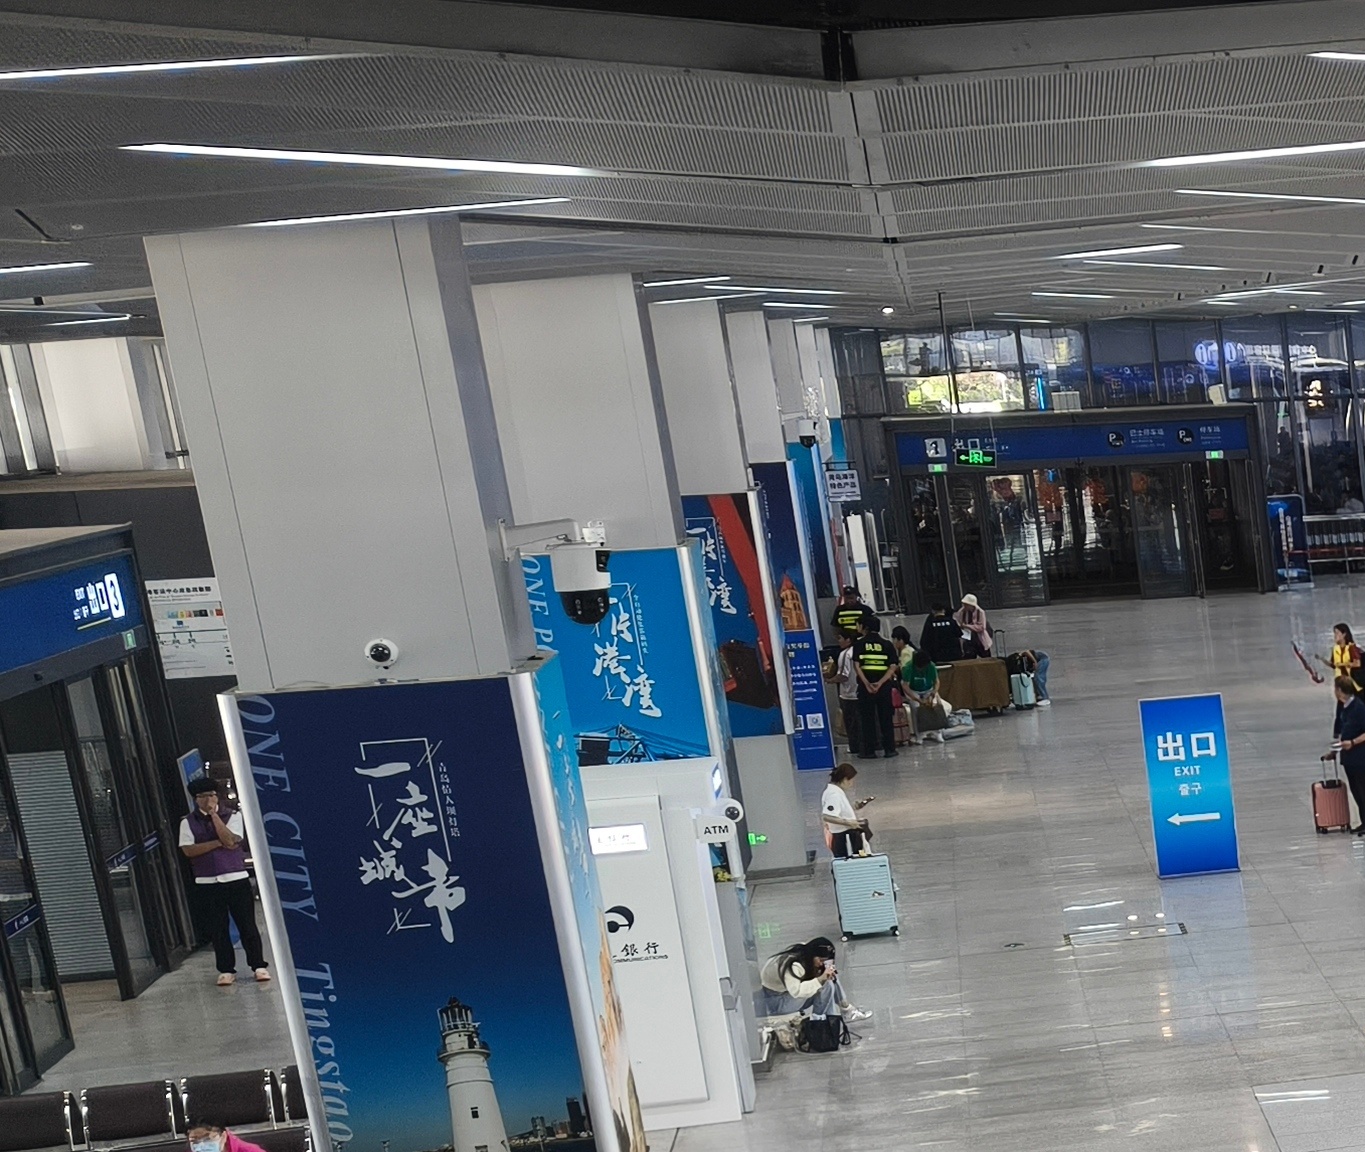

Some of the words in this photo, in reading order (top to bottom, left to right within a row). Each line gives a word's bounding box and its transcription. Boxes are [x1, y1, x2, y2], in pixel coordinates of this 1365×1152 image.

[521, 554, 549, 617] ONE
[238, 695, 291, 793] ONE
[1157, 731, 1217, 762] 出口
[1174, 765, 1201, 777] EXIT
[703, 824, 729, 836] ATM
[262, 811, 319, 922] CITY
